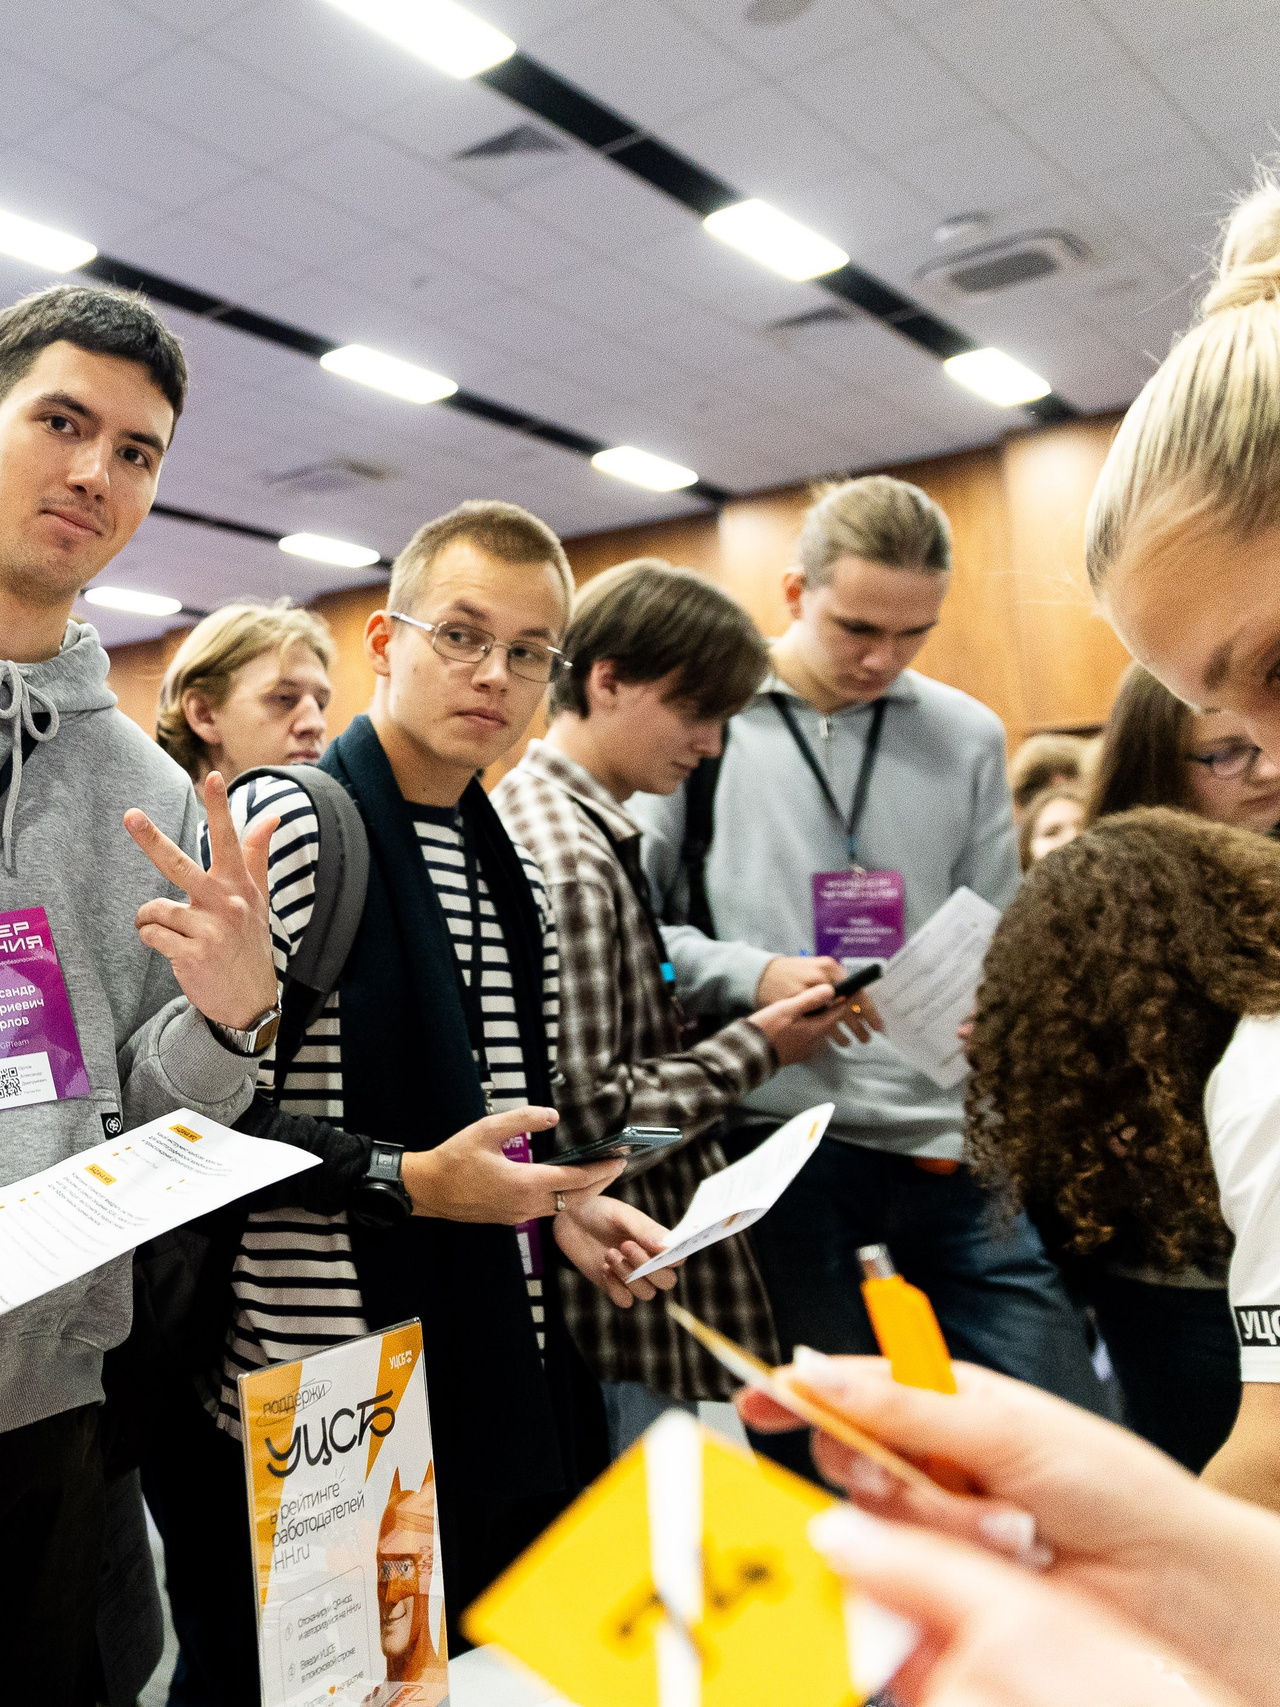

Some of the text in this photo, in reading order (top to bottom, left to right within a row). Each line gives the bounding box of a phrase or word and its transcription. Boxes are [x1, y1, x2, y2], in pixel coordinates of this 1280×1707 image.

[388, 1352, 406, 1370] УЦСБ
[262, 1380, 326, 1418] поддержи
[266, 1390, 395, 1478] УЦСБ
[272, 1490, 365, 1548] работодателей
[280, 1482, 340, 1525] рейтинге
[273, 1543, 310, 1574] HH.ru
